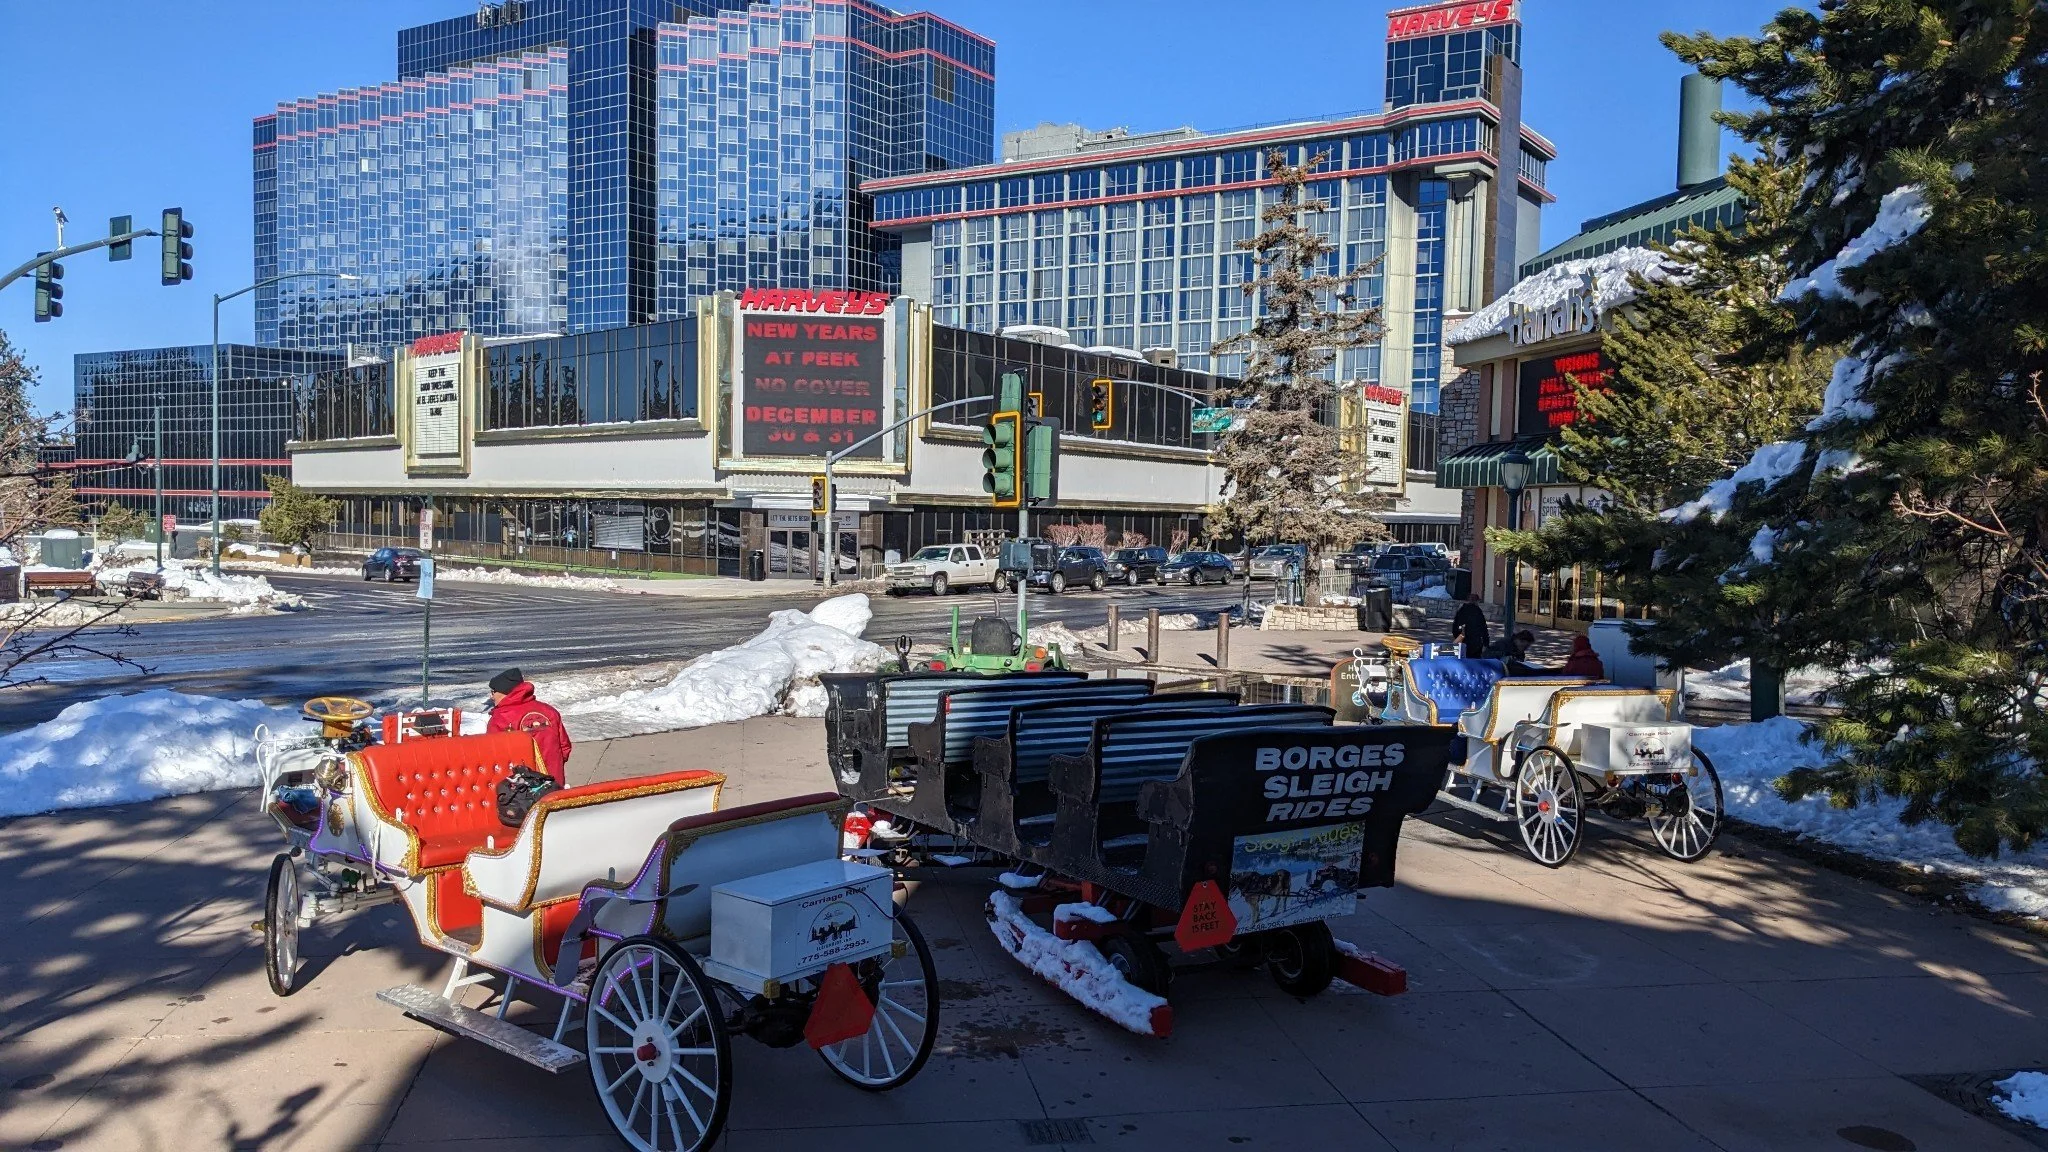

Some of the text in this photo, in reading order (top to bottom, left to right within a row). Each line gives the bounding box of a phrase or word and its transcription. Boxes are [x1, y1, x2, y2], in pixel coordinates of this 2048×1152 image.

[1388, 0, 1512, 38] HARVEYS
[740, 288, 889, 315] HARVEYS
[747, 323, 877, 341] NEW YEARS
[765, 351, 860, 367] AT PEEK
[755, 377, 871, 397] NO COVER
[746, 406, 877, 425] DECEMBER
[1255, 743, 1405, 771] BORGES
[1263, 770, 1393, 799] SLEIGH
[1265, 797, 1374, 822] RIDES
[1193, 901, 1216, 913] STAY
[1193, 911, 1217, 922] BACK
[1192, 920, 1219, 933] 15 FEET
